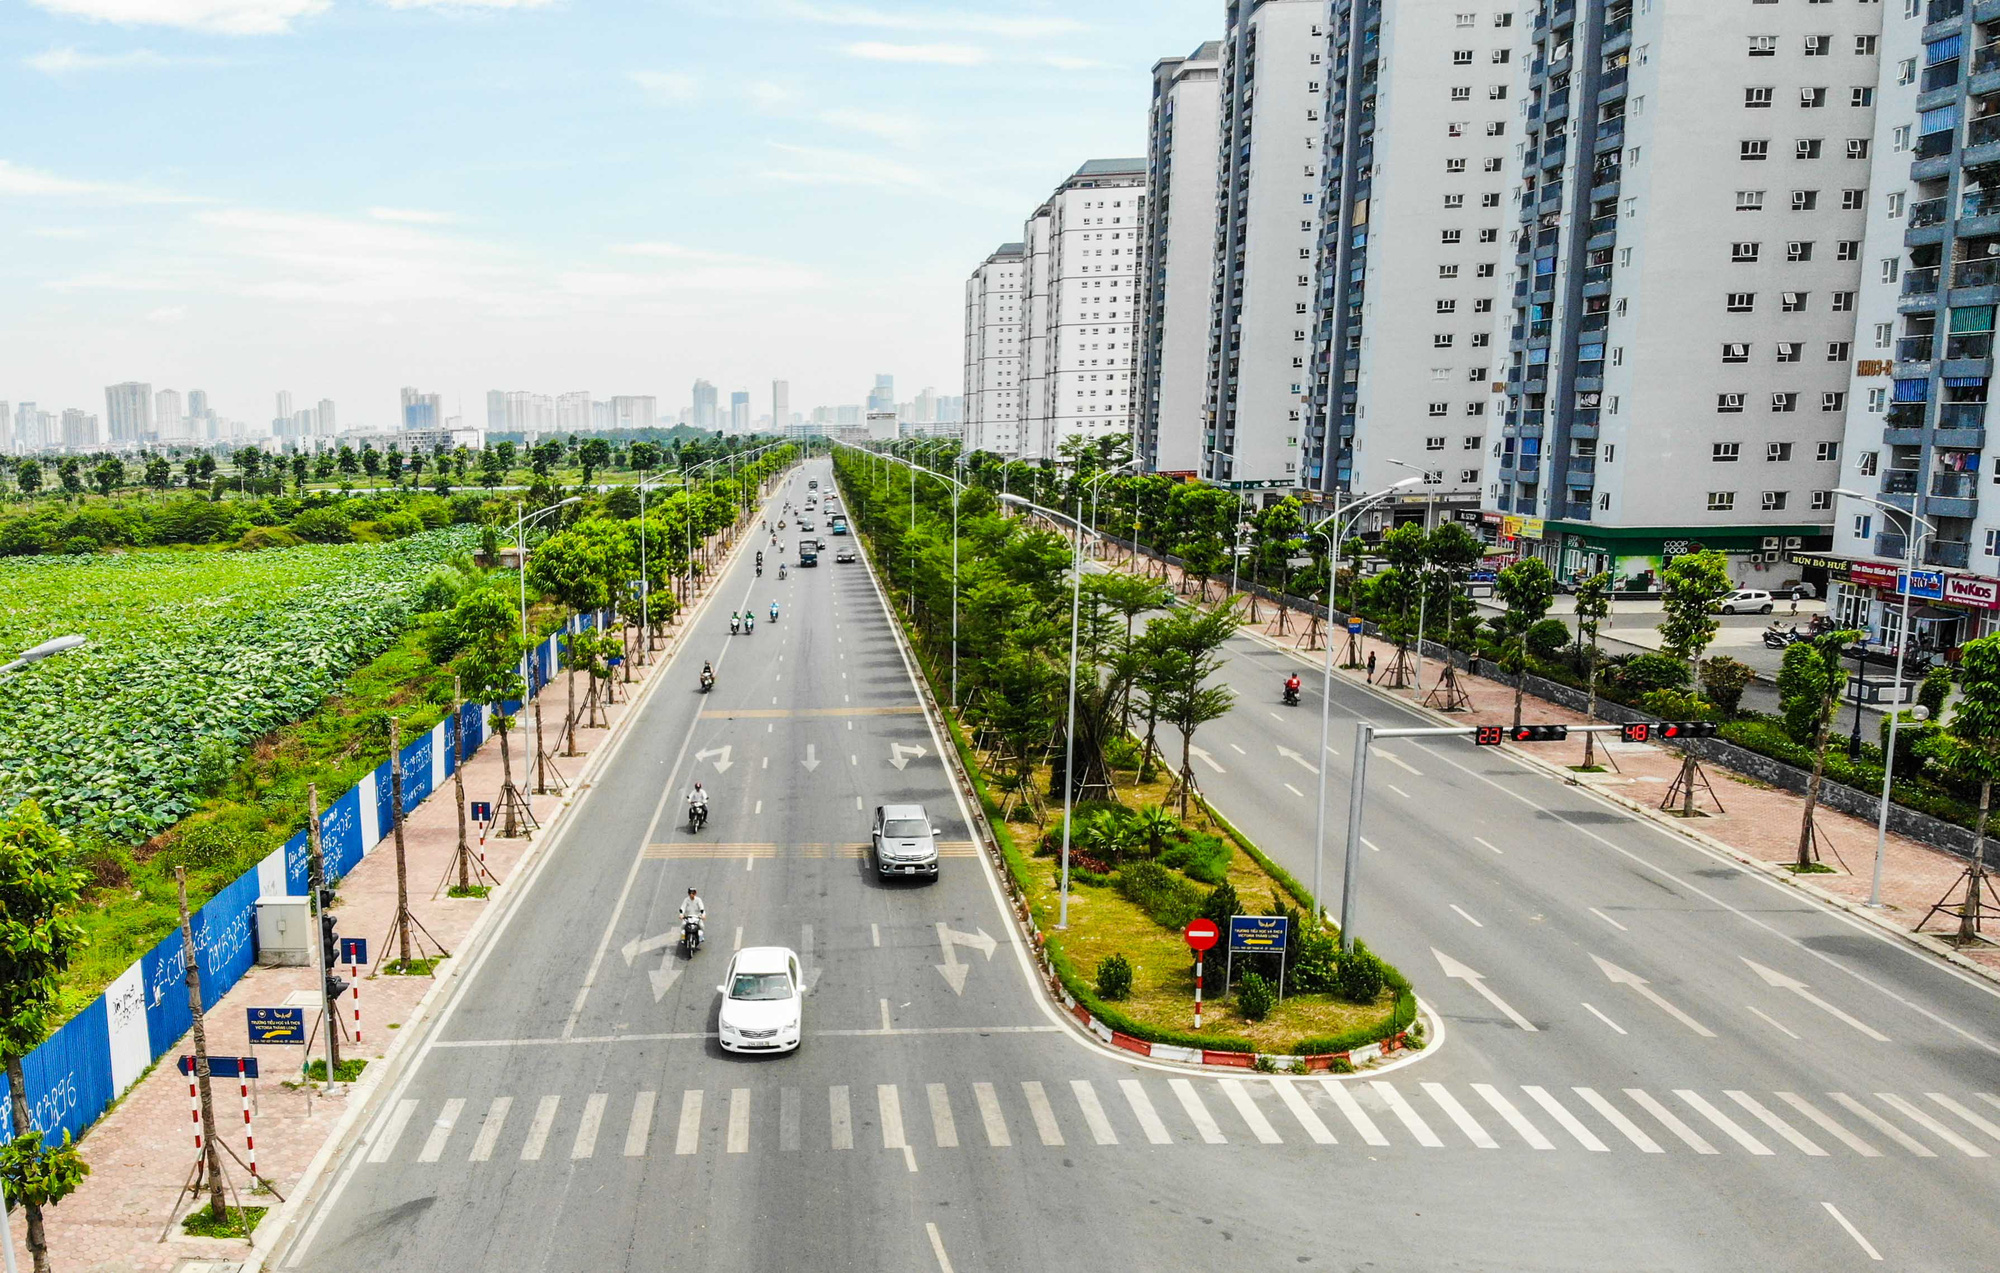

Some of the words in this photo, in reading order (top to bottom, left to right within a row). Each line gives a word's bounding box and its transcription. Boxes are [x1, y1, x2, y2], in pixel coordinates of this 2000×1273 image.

[1792, 555, 1811, 565] BÚN
[1813, 558, 1825, 567] BÒ
[1827, 561, 1848, 570] HUẾ
[1478, 727, 1500, 744] 23
[1625, 724, 1649, 741] 48
